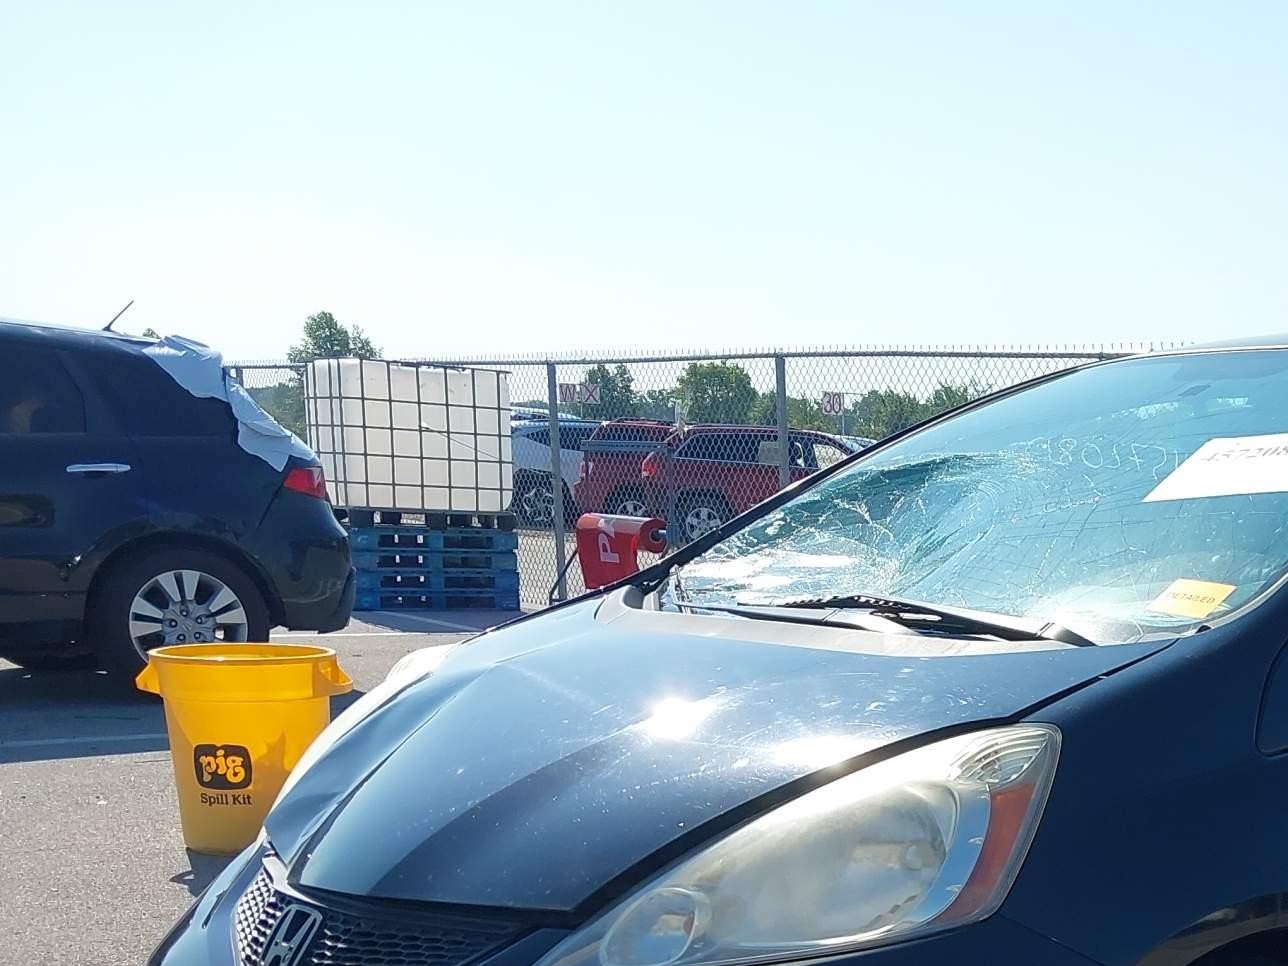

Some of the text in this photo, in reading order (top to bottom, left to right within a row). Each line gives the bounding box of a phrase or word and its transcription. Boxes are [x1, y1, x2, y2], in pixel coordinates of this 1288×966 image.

[559, 384, 600, 403] W X
[822, 392, 842, 414] 30
[199, 749, 246, 783] pig
[200, 793, 253, 807] Spill Kit
